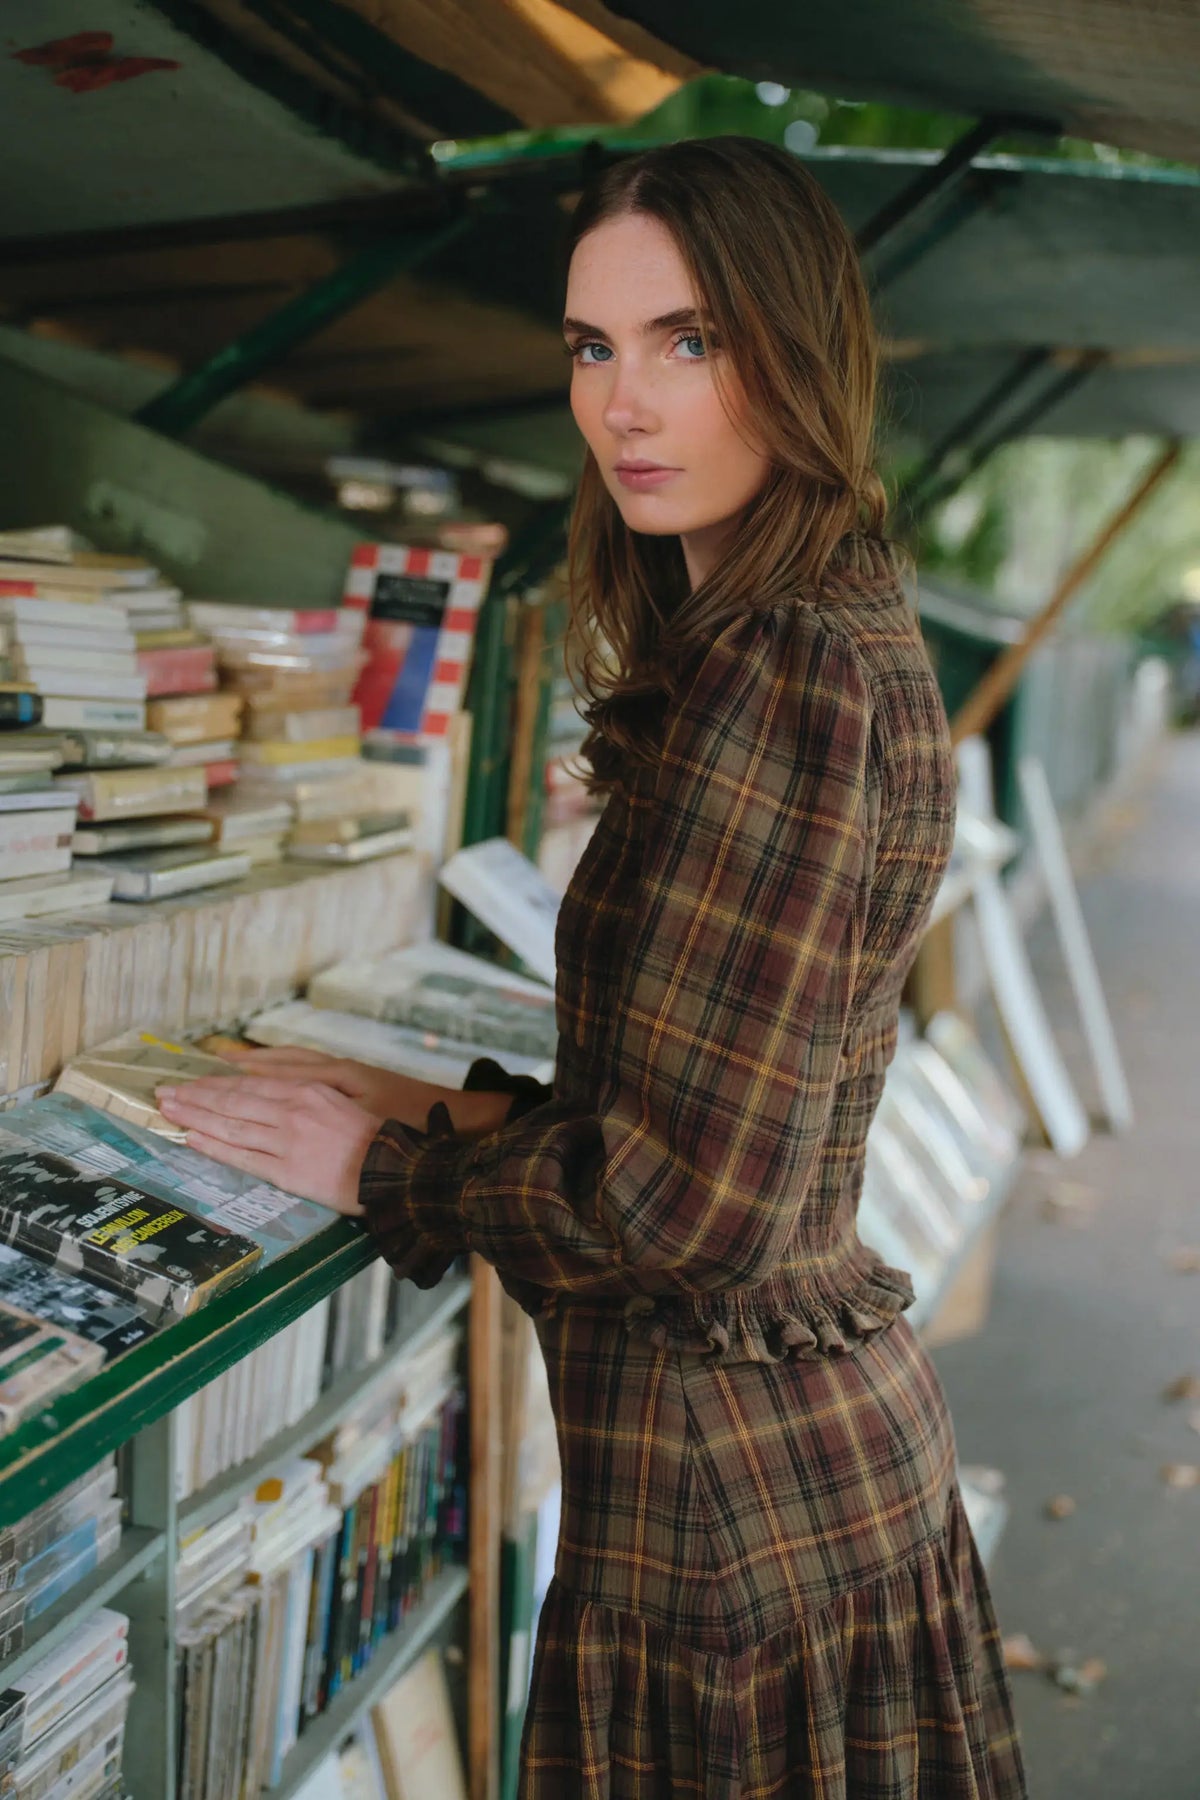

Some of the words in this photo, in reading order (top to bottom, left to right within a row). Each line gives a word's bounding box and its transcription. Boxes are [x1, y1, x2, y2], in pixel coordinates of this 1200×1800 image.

[87, 1229, 110, 1246] LE
[100, 1208, 150, 1236] PAVILLON
[110, 1236, 139, 1254] DES
